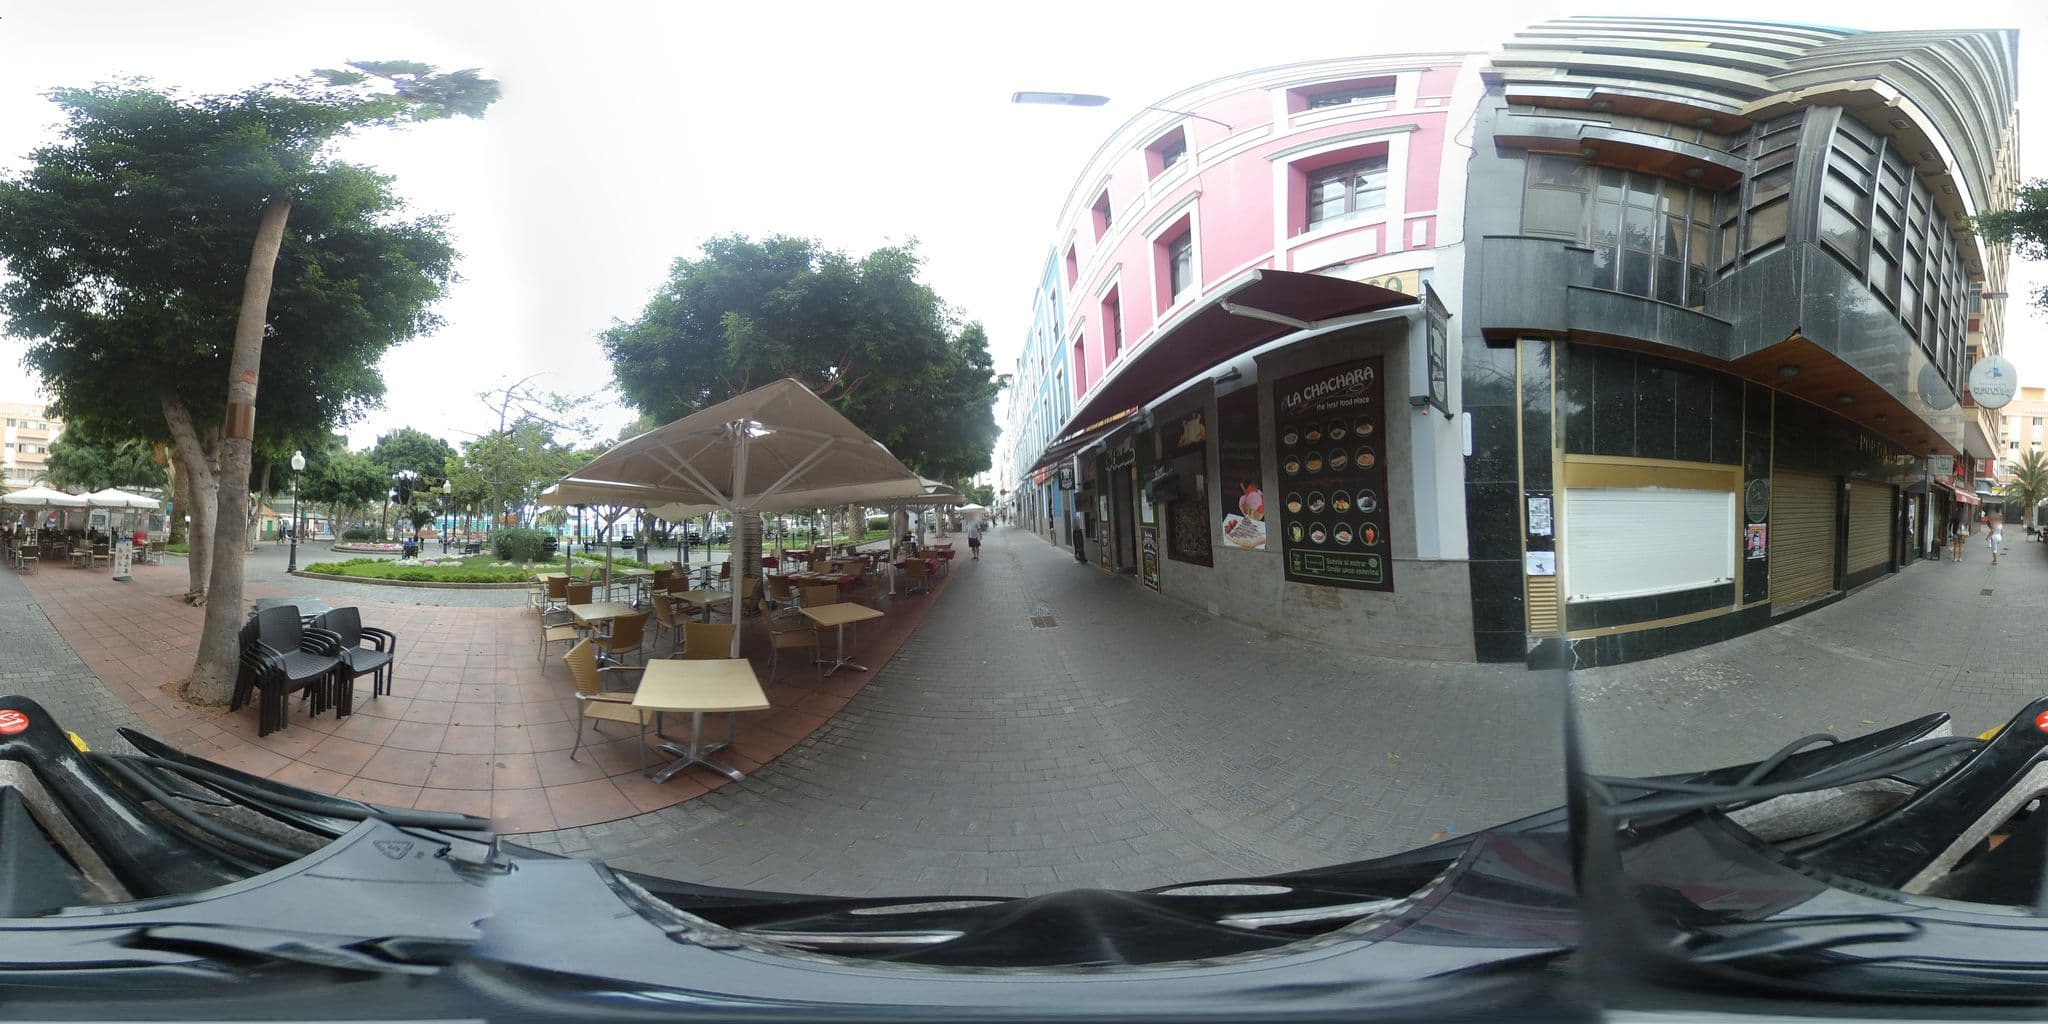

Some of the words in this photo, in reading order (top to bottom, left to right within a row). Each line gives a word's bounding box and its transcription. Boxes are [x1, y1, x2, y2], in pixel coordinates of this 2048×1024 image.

[1286, 391, 1302, 408] LA
[1303, 366, 1374, 400] CHACHARA
[1317, 403, 1325, 411] the
[1326, 401, 1339, 410] best
[1339, 398, 1353, 408] food
[1353, 395, 1370, 407] place
